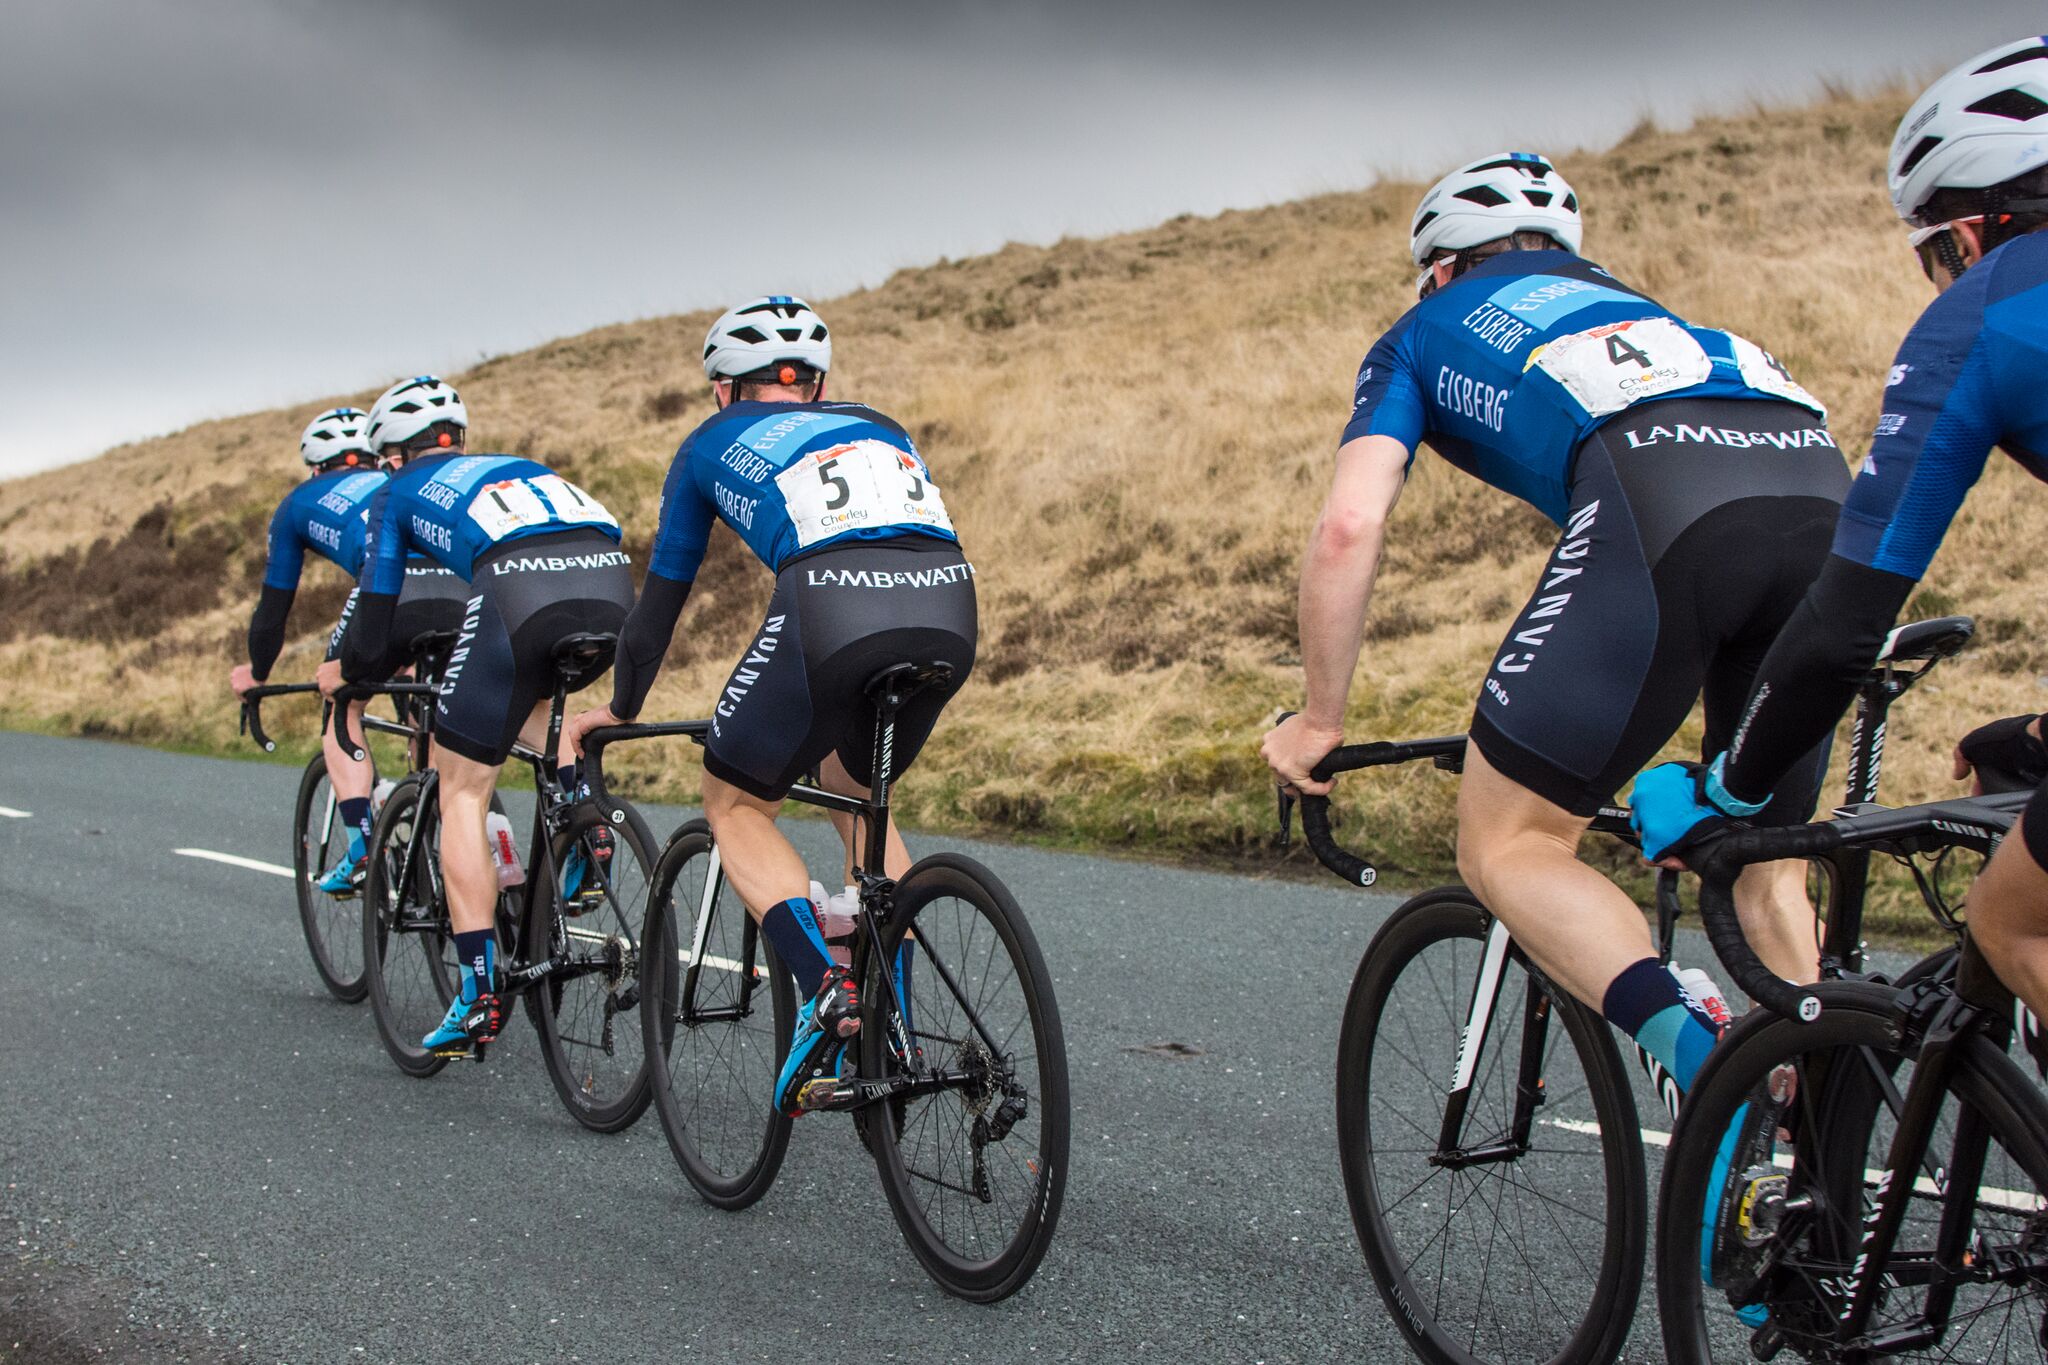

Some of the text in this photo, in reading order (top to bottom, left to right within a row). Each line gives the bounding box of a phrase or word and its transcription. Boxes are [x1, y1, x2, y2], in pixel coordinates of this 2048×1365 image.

[1510, 279, 1600, 312] EISBERG
[1462, 302, 1536, 354] EISBERG
[1605, 333, 1653, 369] 4
[1618, 367, 1680, 390] Chorley
[1437, 365, 1510, 433] EISBERG
[753, 412, 823, 451] EISBERG
[720, 442, 774, 483] EISBERG
[417, 480, 460, 511] EISBERG
[818, 459, 850, 510] 5
[715, 481, 757, 531] EISBERG
[821, 509, 869, 528] Chorley
[308, 520, 342, 551] EISBERG
[412, 514, 453, 552] EISBERG
[1497, 499, 1600, 673] CANYON
[439, 594, 484, 696] CANYON
[717, 614, 787, 718] CANYON
[1486, 678, 1510, 706] dhb
[881, 722, 895, 779] CANYON
[1863, 721, 1887, 802] CANYON
[1931, 820, 1989, 839] CANYON
[1364, 871, 1374, 882] 3T
[473, 955, 486, 976] dhb
[1805, 1002, 1817, 1016] 3T
